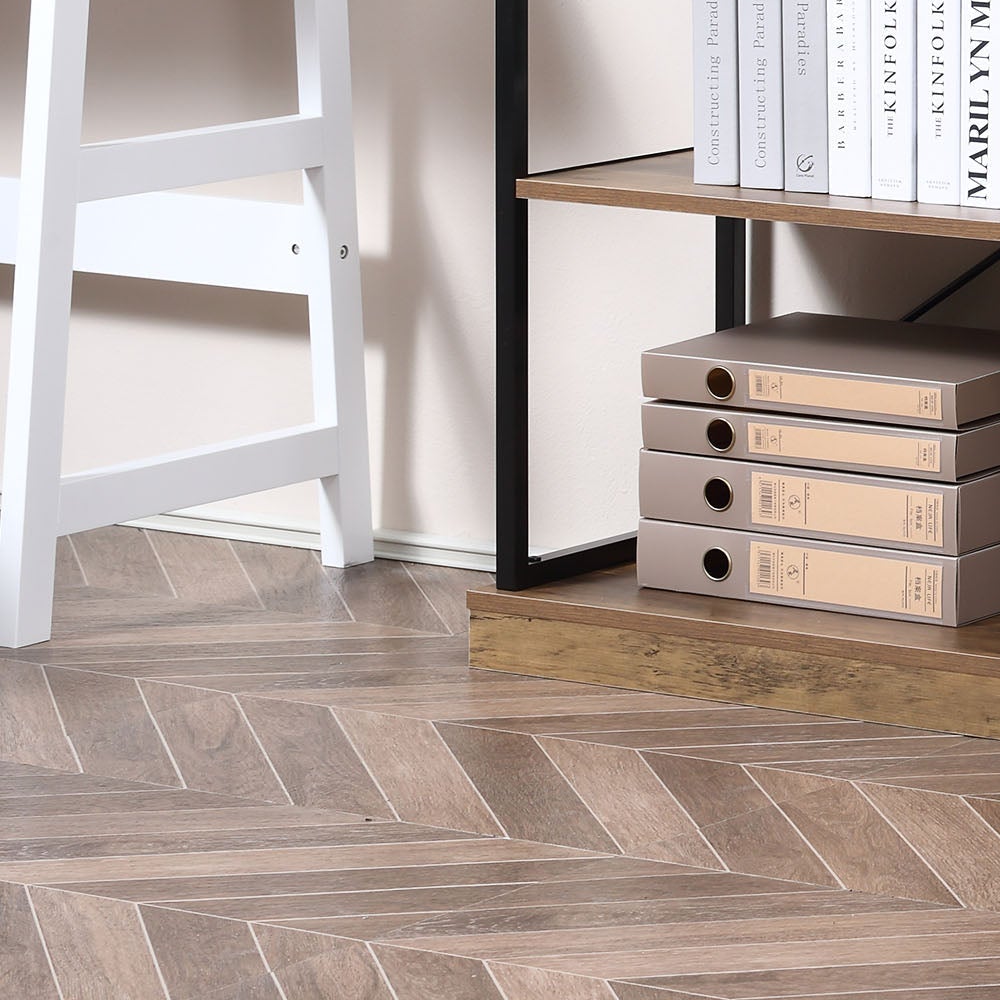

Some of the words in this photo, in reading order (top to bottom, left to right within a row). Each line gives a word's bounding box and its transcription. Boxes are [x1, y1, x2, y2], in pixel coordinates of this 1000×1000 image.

[797, 2, 810, 77] Paradies
[883, 1, 897, 113] KINFOLK
[931, 1, 945, 115] KINFOLK
[706, 55, 721, 166] Constructing
[753, 57, 768, 169] Constructing
[887, 115, 895, 137] THE
[935, 116, 943, 138] THE
